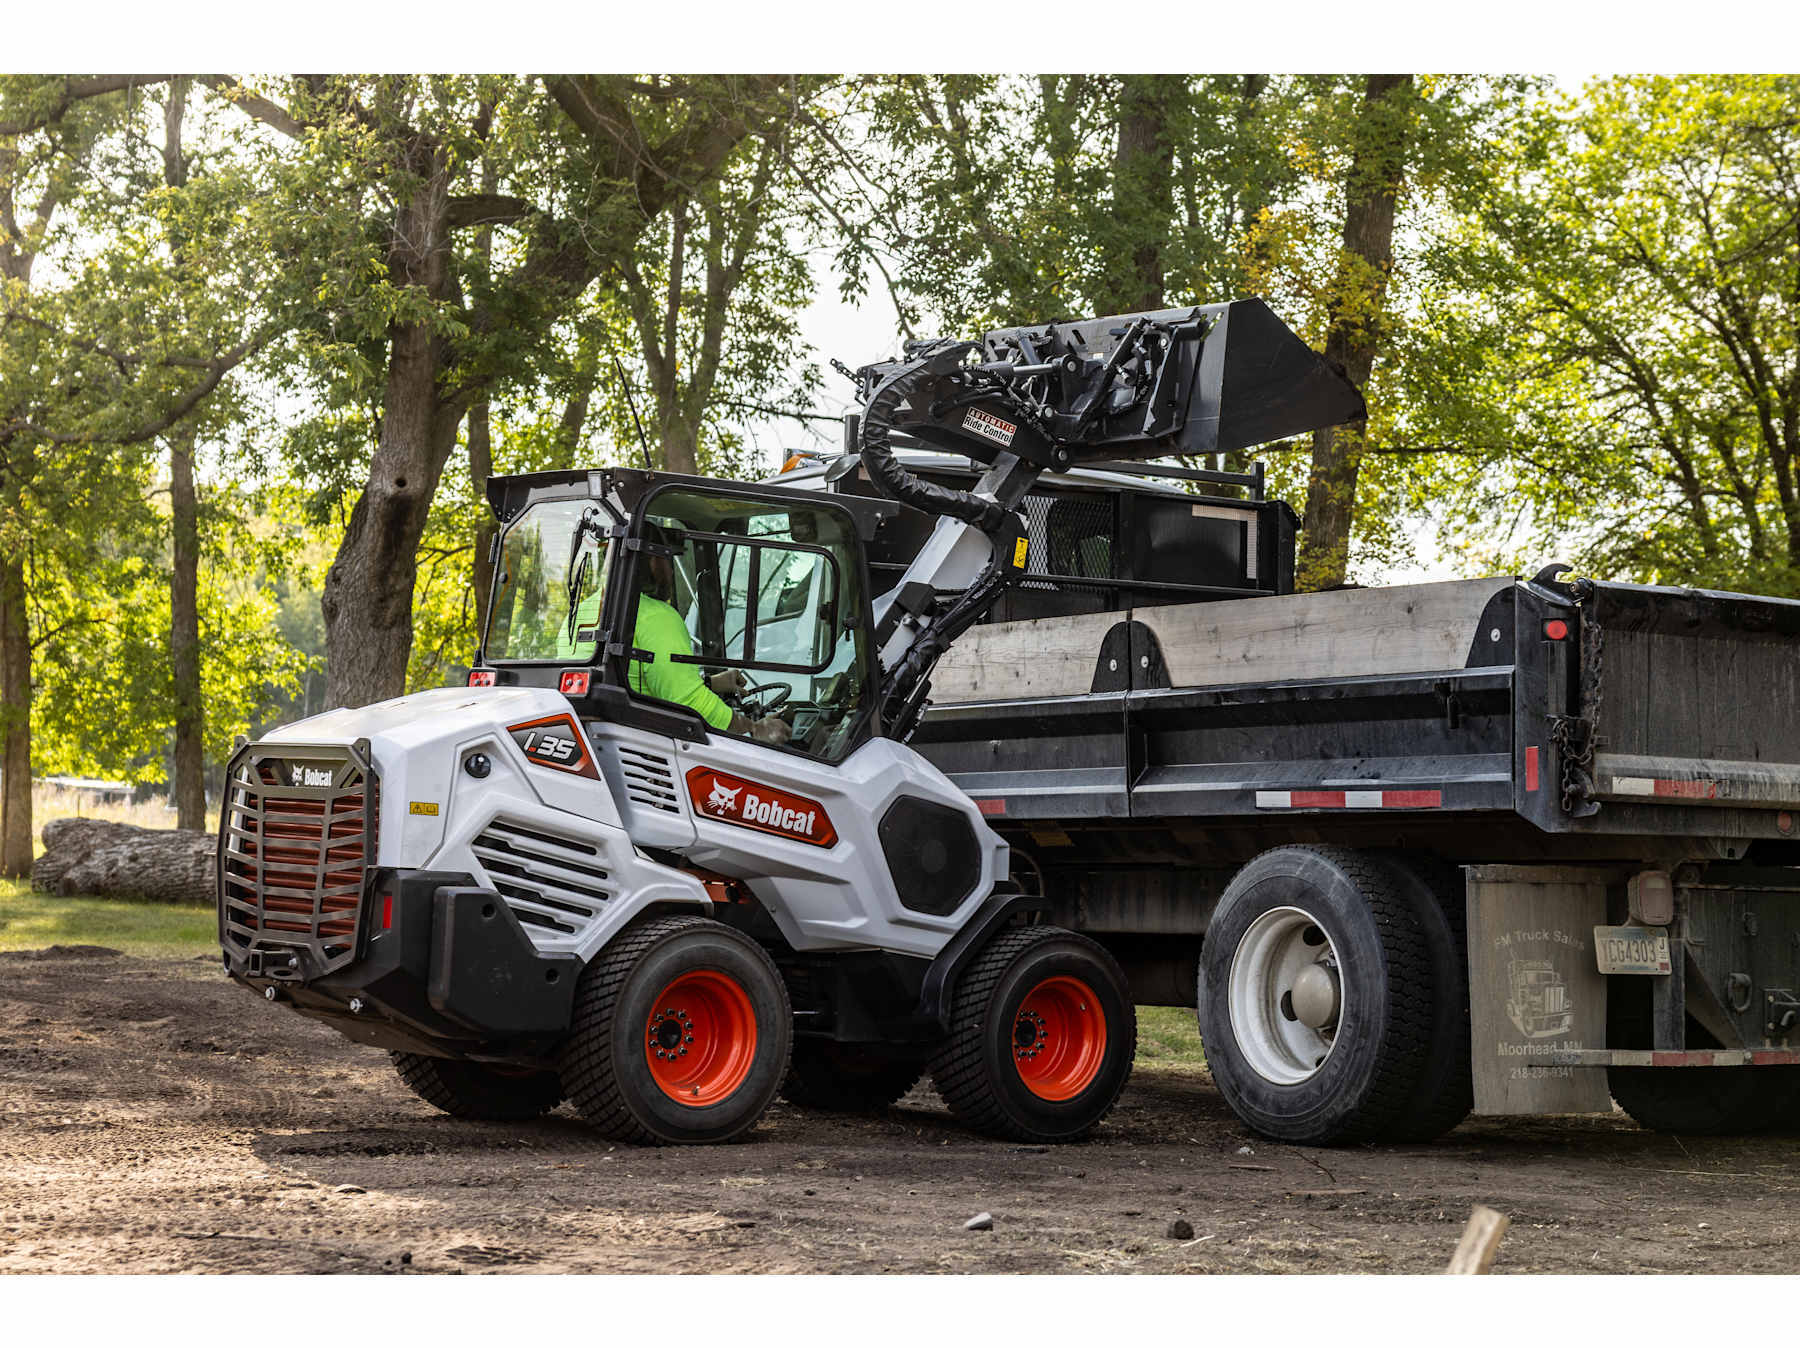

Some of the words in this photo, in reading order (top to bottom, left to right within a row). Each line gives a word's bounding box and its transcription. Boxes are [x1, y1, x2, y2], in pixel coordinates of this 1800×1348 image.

[964, 416, 983, 431] Ride
[984, 424, 1013, 443] Control
[970, 410, 1014, 433] AUTOMATIC
[304, 768, 333, 787] Bobcat
[742, 794, 816, 836] Bobcat
[1512, 927, 1550, 942] Truck
